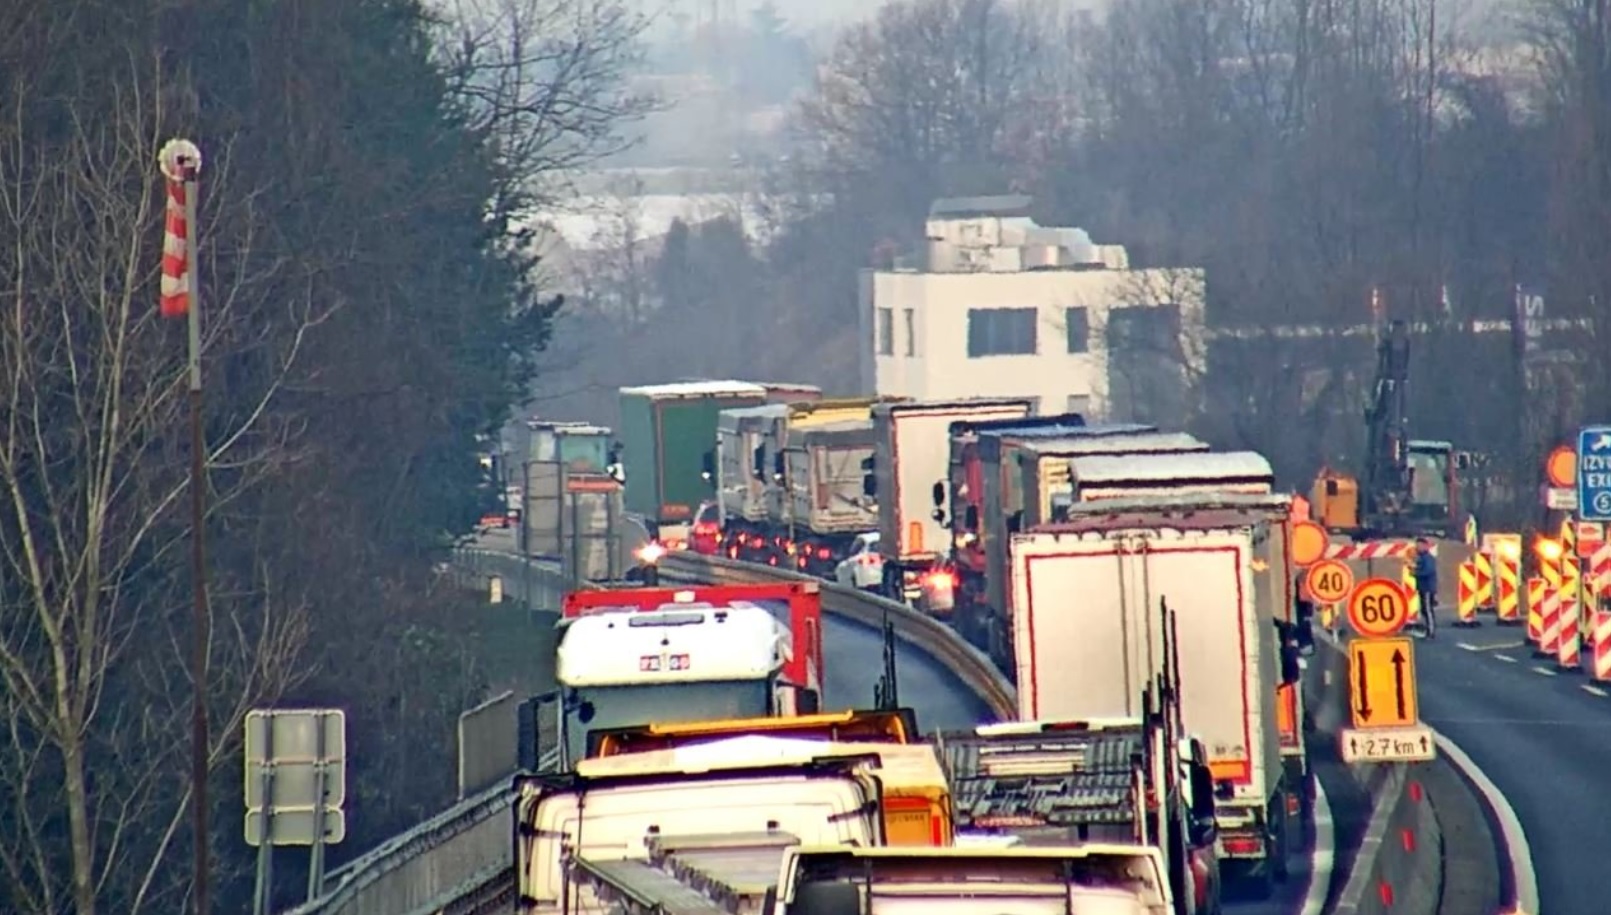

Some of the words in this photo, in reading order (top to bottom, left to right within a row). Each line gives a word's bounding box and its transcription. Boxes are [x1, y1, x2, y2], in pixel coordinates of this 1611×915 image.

[1319, 572, 1343, 593] 40
[1361, 594, 1395, 623] 60
[1393, 738, 1414, 755] km
